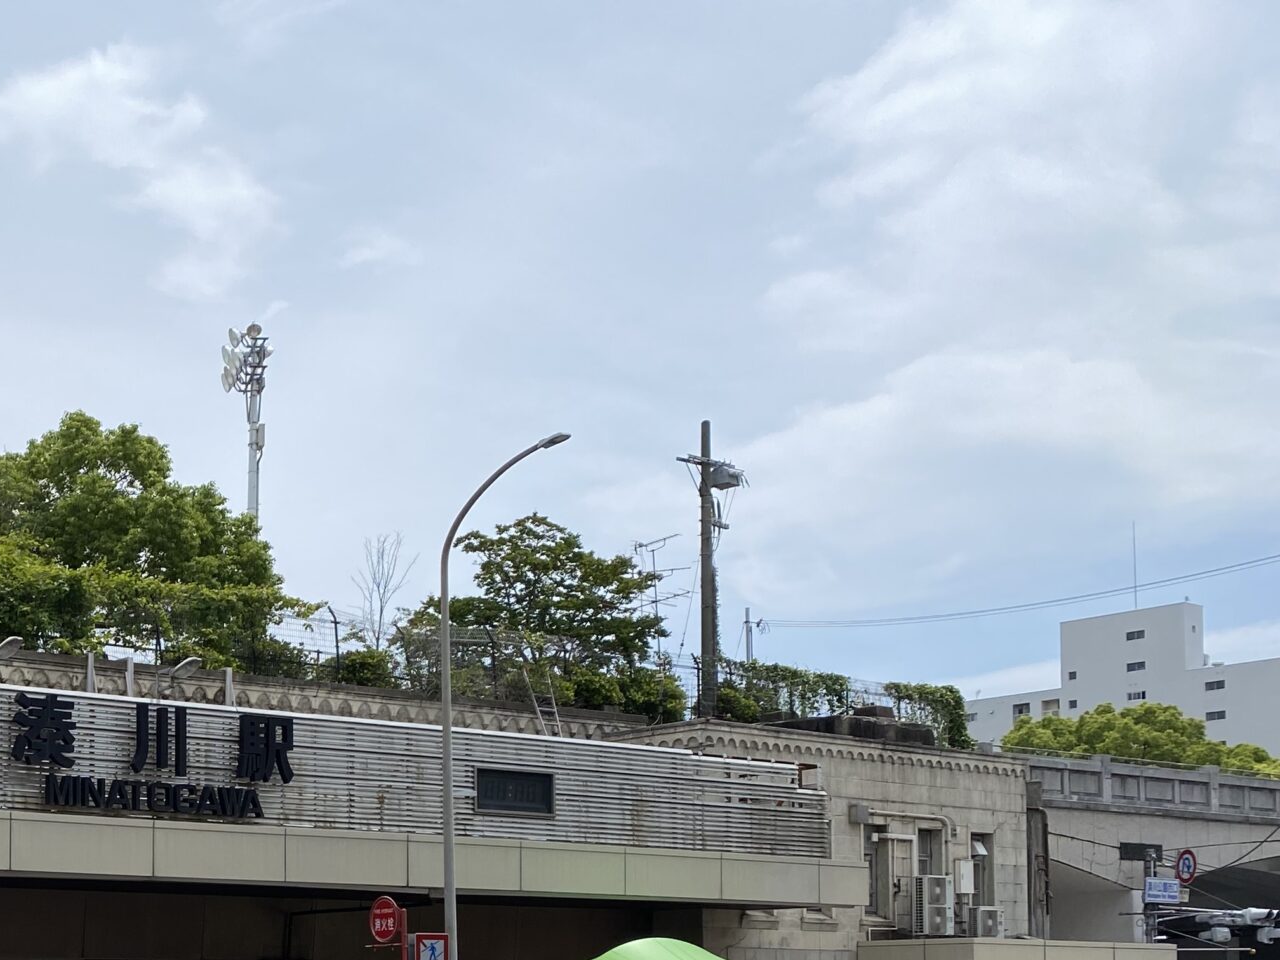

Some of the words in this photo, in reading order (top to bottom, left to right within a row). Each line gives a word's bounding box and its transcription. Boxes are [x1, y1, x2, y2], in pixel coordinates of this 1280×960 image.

[45, 776, 264, 818] MINATOGAWA
[374, 916, 394, 931] 消火栓
